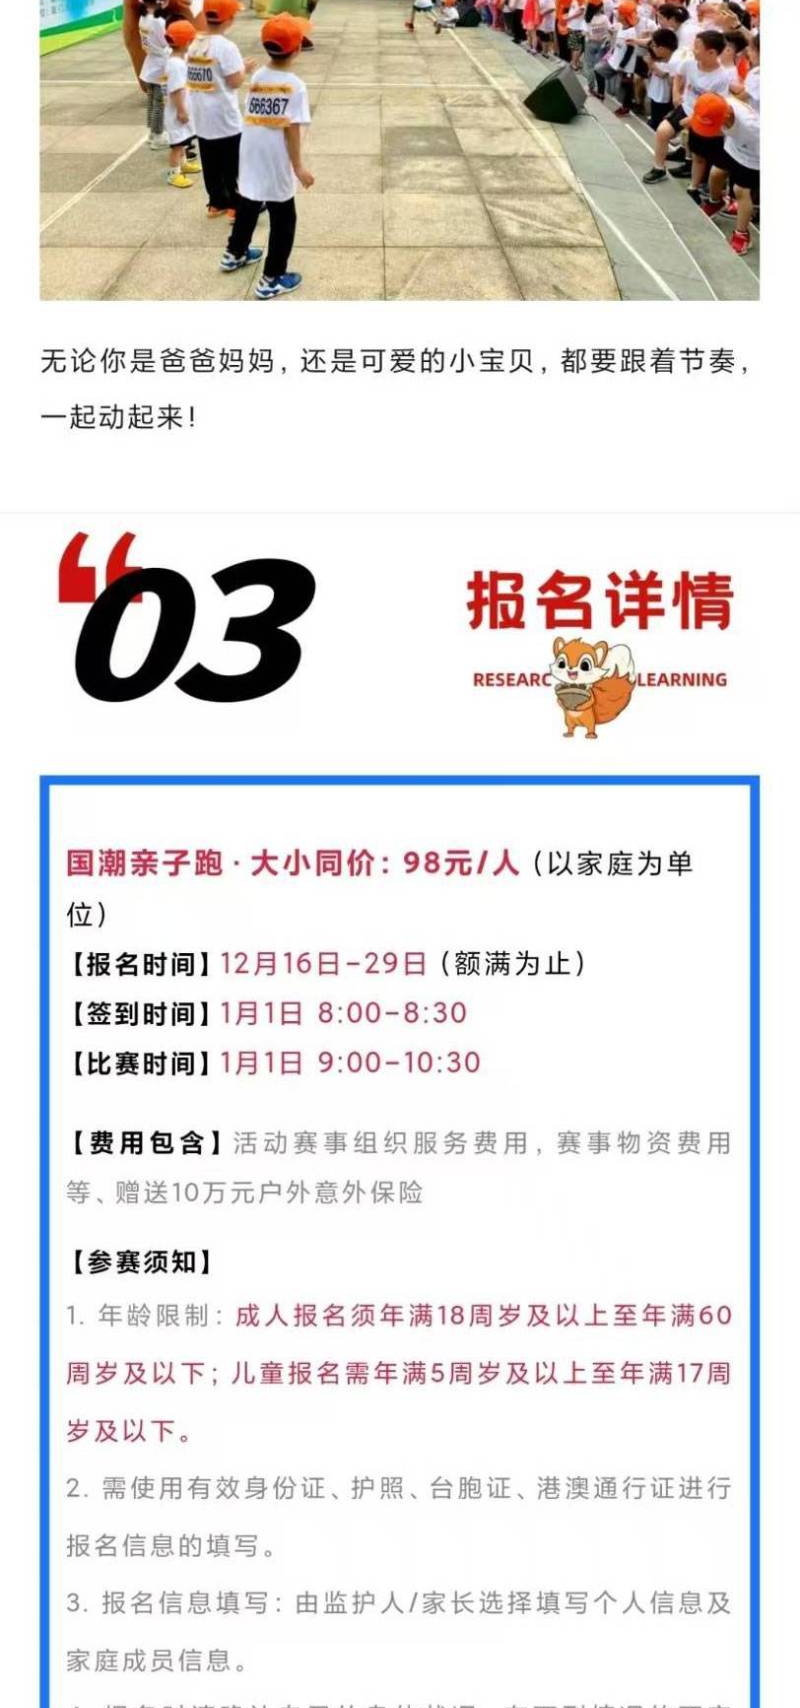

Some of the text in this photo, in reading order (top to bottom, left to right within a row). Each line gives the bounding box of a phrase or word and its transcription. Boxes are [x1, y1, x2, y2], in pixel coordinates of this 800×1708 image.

[467, 569, 734, 630] 报名详情
[75, 558, 316, 703] 03
[473, 672, 727, 687] RESEARC LEARNING
[67, 1180, 423, 1205] 等、赠送10万元户外意外保险
[75, 1249, 210, 1276] 【参赛须知】
[67, 1419, 190, 1444] 岁及以下。
[67, 1534, 273, 1558] 报名信息的填写。
[67, 1648, 245, 1673] 家庭成员信息。
